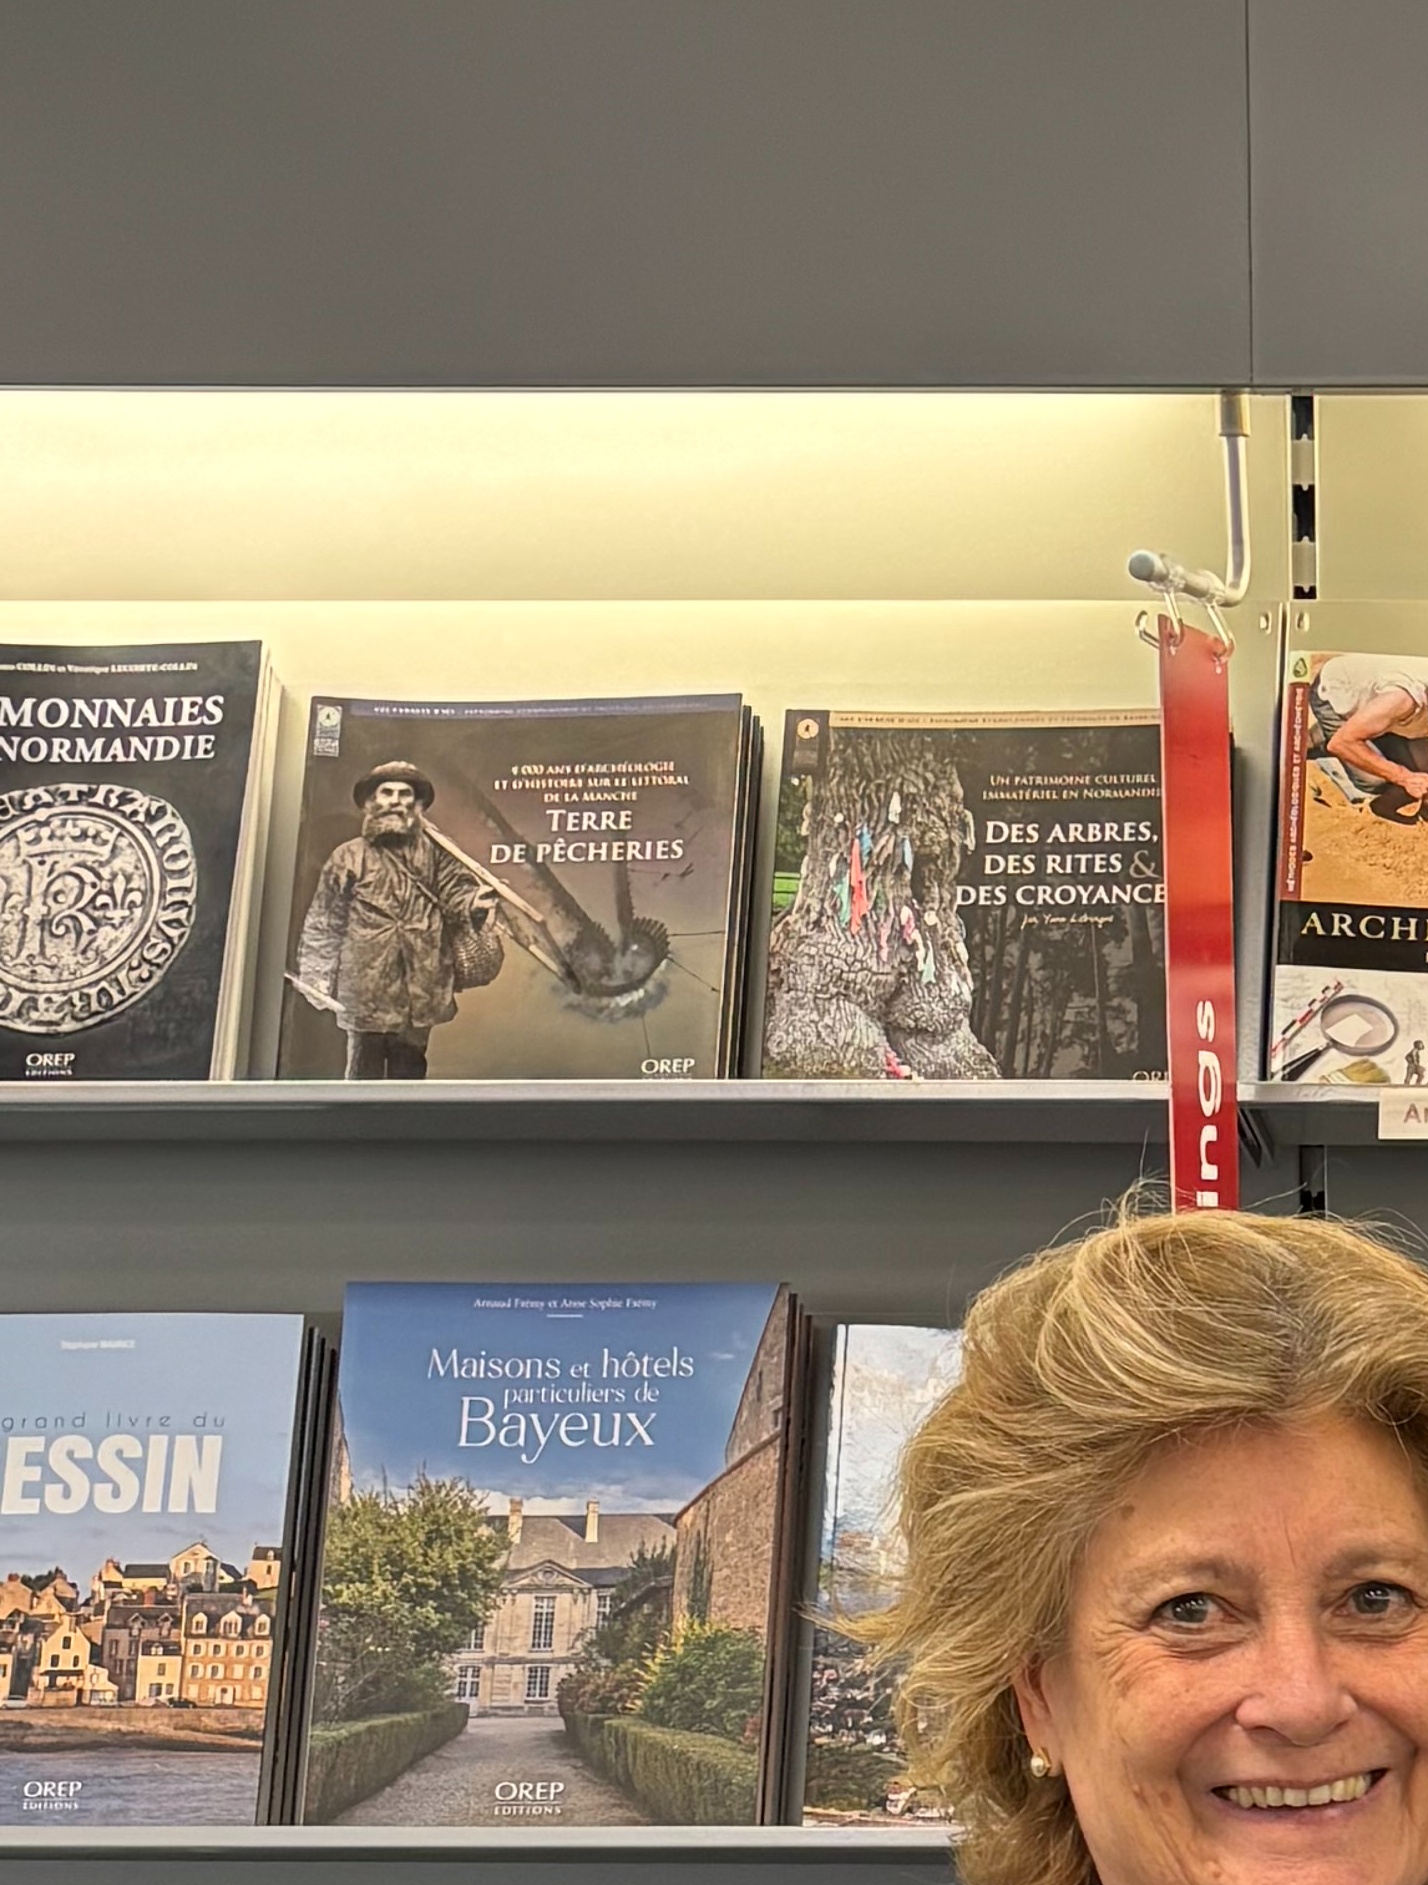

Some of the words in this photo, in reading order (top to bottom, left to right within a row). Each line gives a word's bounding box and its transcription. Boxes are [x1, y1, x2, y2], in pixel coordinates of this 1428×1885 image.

[0, 695, 225, 728] MONNAIES
[0, 735, 216, 763] NORMANDIE
[543, 792, 562, 802] DE
[582, 791, 638, 802] MANCHE
[1062, 789, 1080, 799] EN
[545, 808, 633, 832] TERRE
[985, 821, 1040, 844] DES
[1047, 820, 1159, 844] ARBRES,
[490, 845, 526, 864] DE
[536, 837, 685, 863] PÊCHERIES
[984, 854, 1036, 875] DES
[1046, 853, 1122, 875] RITES
[1129, 850, 1161, 878] &
[956, 886, 1007, 906] DES
[26, 1052, 75, 1068] OREP
[641, 1058, 696, 1076] OREP
[427, 1348, 561, 1380] Maisons
[569, 1361, 590, 1378] et
[602, 1347, 695, 1379] hôtels
[503, 1381, 626, 1409] particuliers
[634, 1381, 660, 1403] de
[1, 1412, 87, 1434] grand
[106, 1411, 171, 1429] livre
[192, 1411, 227, 1429] du
[458, 1396, 657, 1465] Bayeux
[0, 1434, 223, 1514] ESSIN
[22, 1780, 83, 1798] OREP
[495, 1782, 565, 1801] OREP
